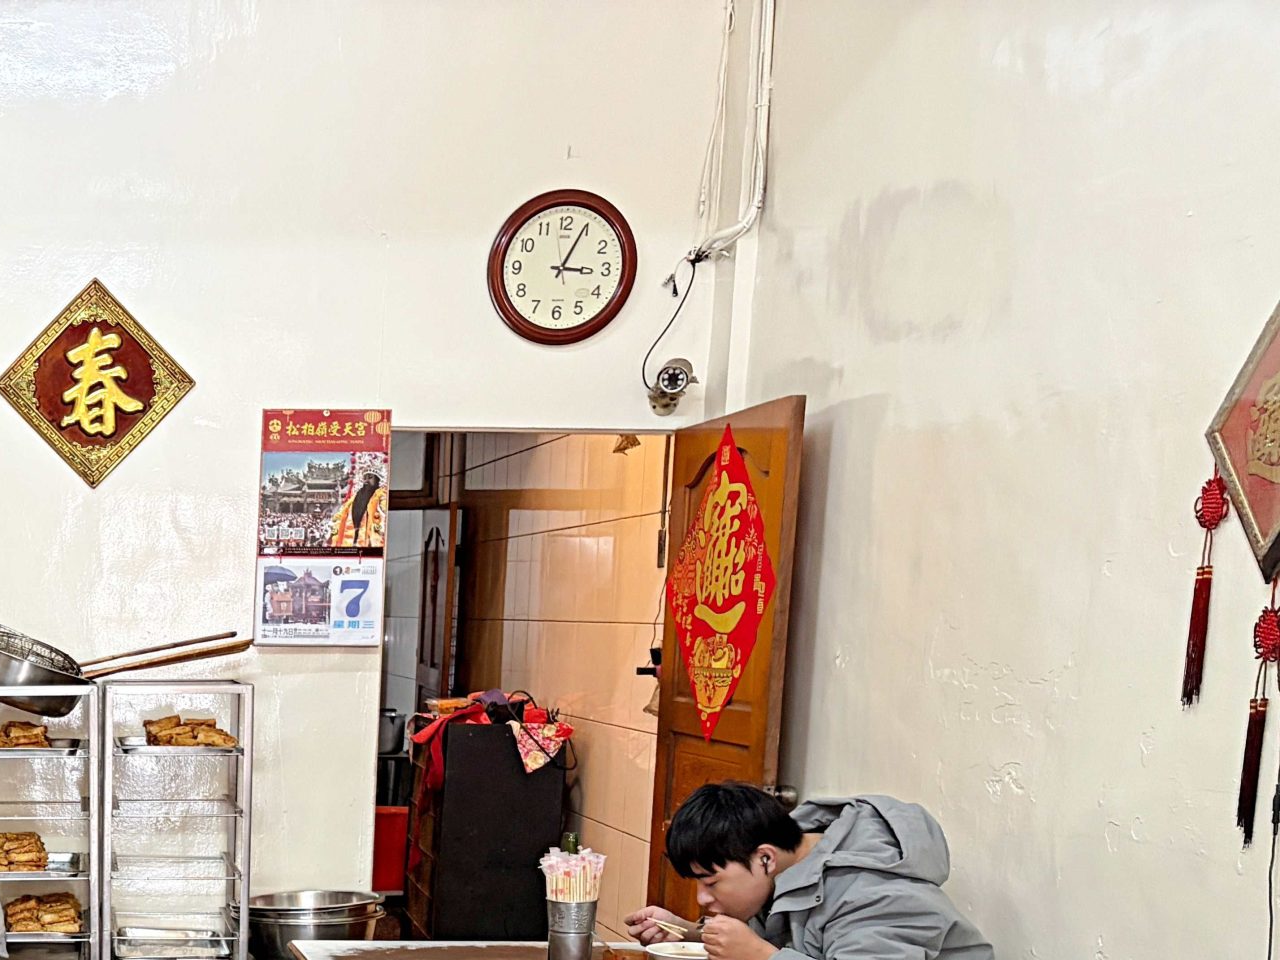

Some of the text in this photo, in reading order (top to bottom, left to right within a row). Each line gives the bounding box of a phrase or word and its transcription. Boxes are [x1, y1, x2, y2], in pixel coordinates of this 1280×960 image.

[538, 221, 551, 236] 11
[559, 215, 574, 231] 12
[520, 237, 535, 253] 10
[596, 239, 608, 255] 2
[511, 260, 523, 275] 9
[600, 261, 612, 277] 3
[515, 282, 527, 298] 8
[590, 284, 602, 299] 4
[531, 299, 541, 314] 7
[551, 305, 562, 321] 6
[573, 300, 584, 315] 5
[59, 327, 145, 438] 春
[285, 421, 368, 438] 松柏嶺受天宮
[339, 579, 370, 618] 7
[332, 620, 375, 630] 星期三
